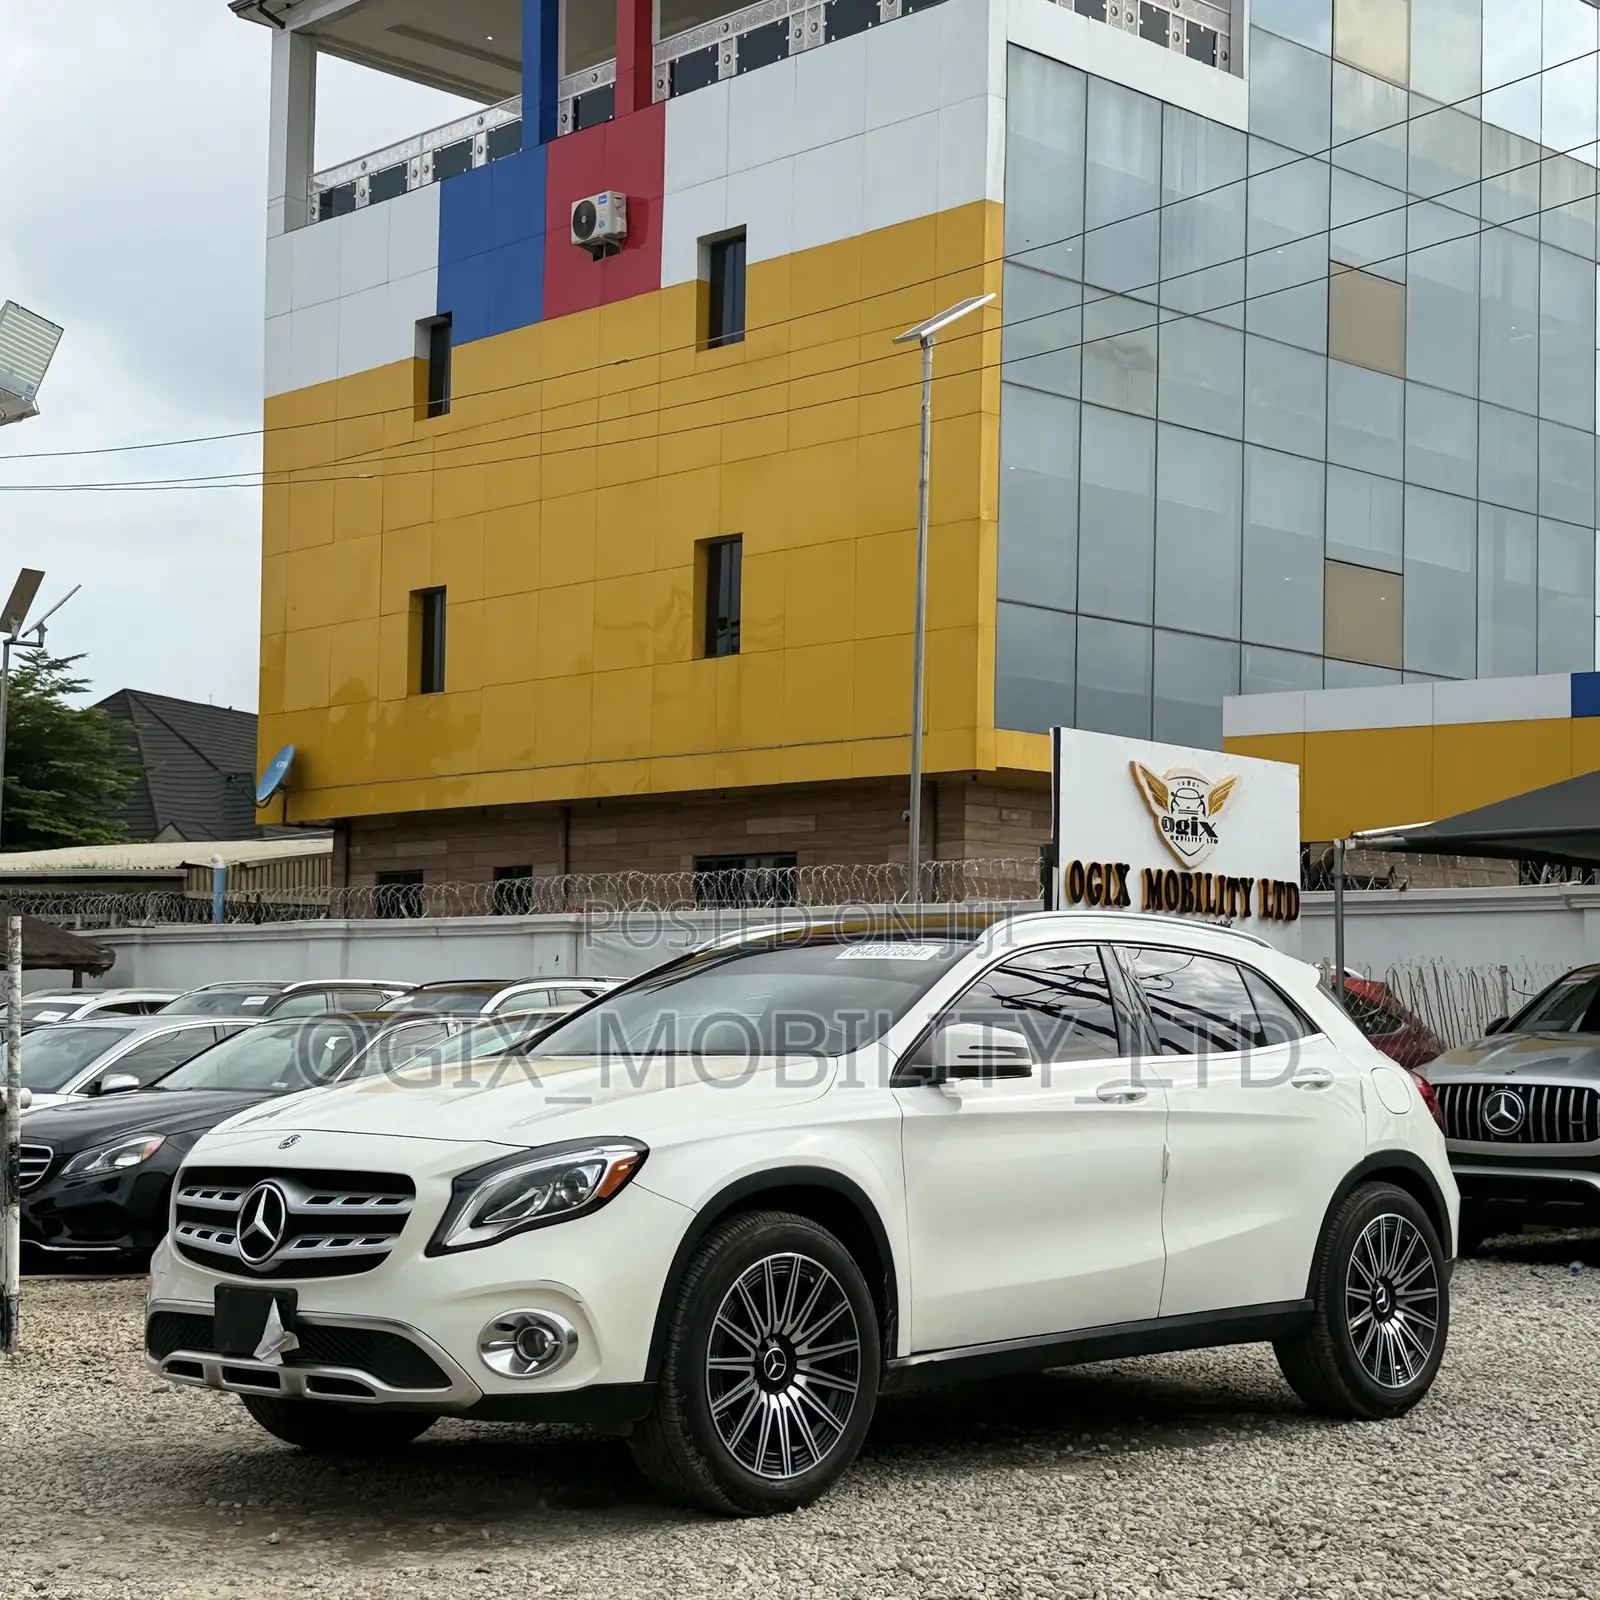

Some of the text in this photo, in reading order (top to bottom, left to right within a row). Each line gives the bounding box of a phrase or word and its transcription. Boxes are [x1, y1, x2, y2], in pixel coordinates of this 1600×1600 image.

[1066, 860, 1300, 921] OGIX MOBILITY LTD
